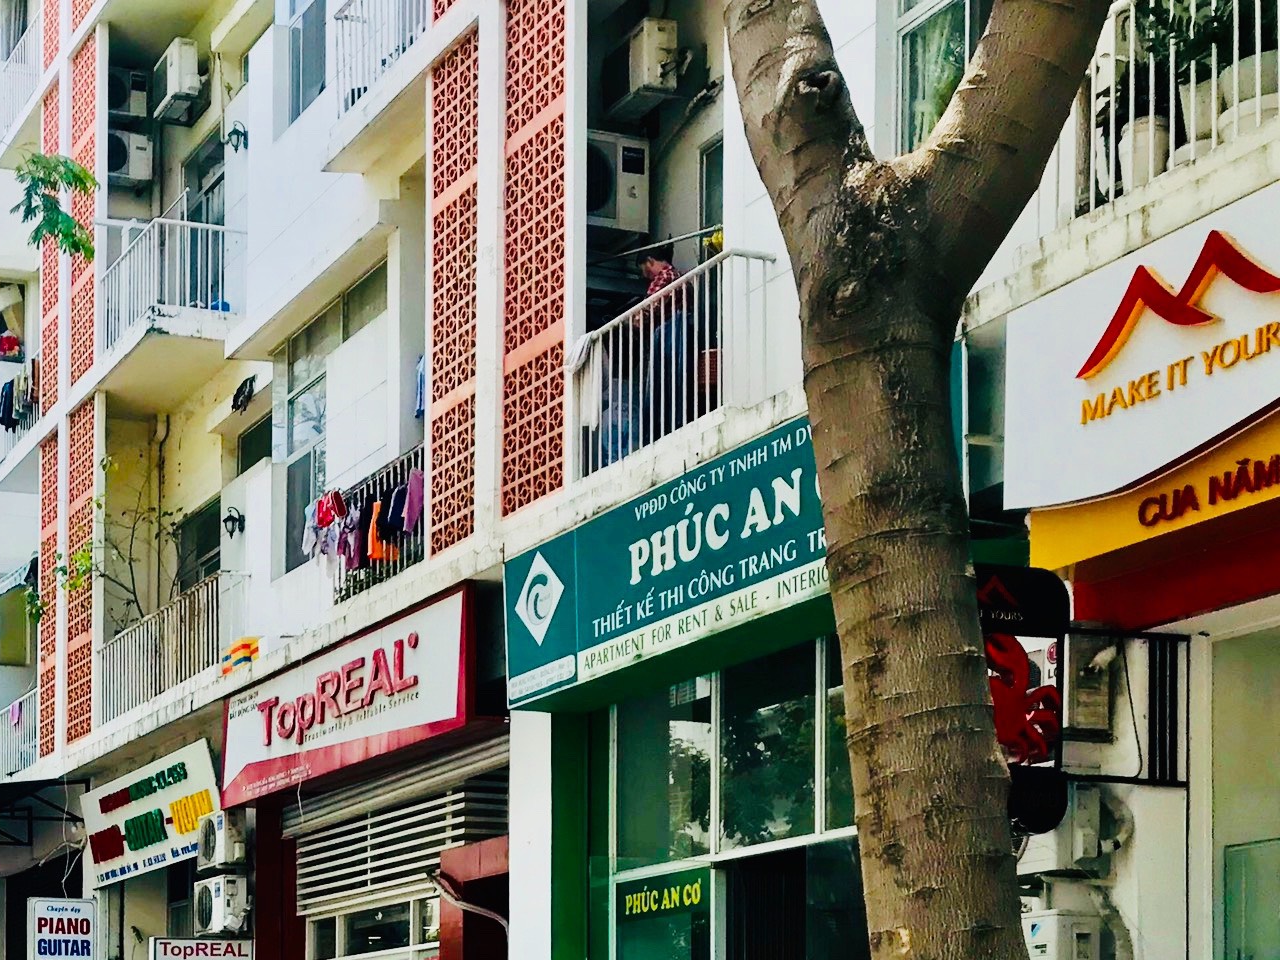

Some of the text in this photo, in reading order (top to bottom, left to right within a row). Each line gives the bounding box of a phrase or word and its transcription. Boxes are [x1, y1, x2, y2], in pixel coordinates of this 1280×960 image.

[1080, 370, 1160, 425] MAKE
[1167, 355, 1194, 391] IT
[670, 473, 706, 505] CÔNG
[709, 464, 725, 487] TY
[729, 447, 768, 478] TNHH
[771, 435, 792, 460] TM
[1138, 484, 1200, 527] CUA
[628, 467, 803, 585] PHÚC AN
[592, 600, 632, 638] THIẾT
[636, 595, 655, 621] KẾ
[658, 582, 684, 610] THI
[688, 570, 734, 600] CÔNG
[739, 539, 797, 580] TRANG
[583, 633, 646, 671] APARTMENT
[652, 625, 672, 646] FOR
[678, 608, 708, 637] RENT
[714, 604, 723, 621] &
[730, 590, 758, 617] SALE
[990, 609, 1024, 621] YOURS
[388, 691, 419, 710] Service
[625, 878, 701, 915] PHÚC AN CƠ
[38, 917, 91, 935] PIANO
[38, 938, 91, 957] GUITAR
[159, 941, 249, 960] TopREAL
